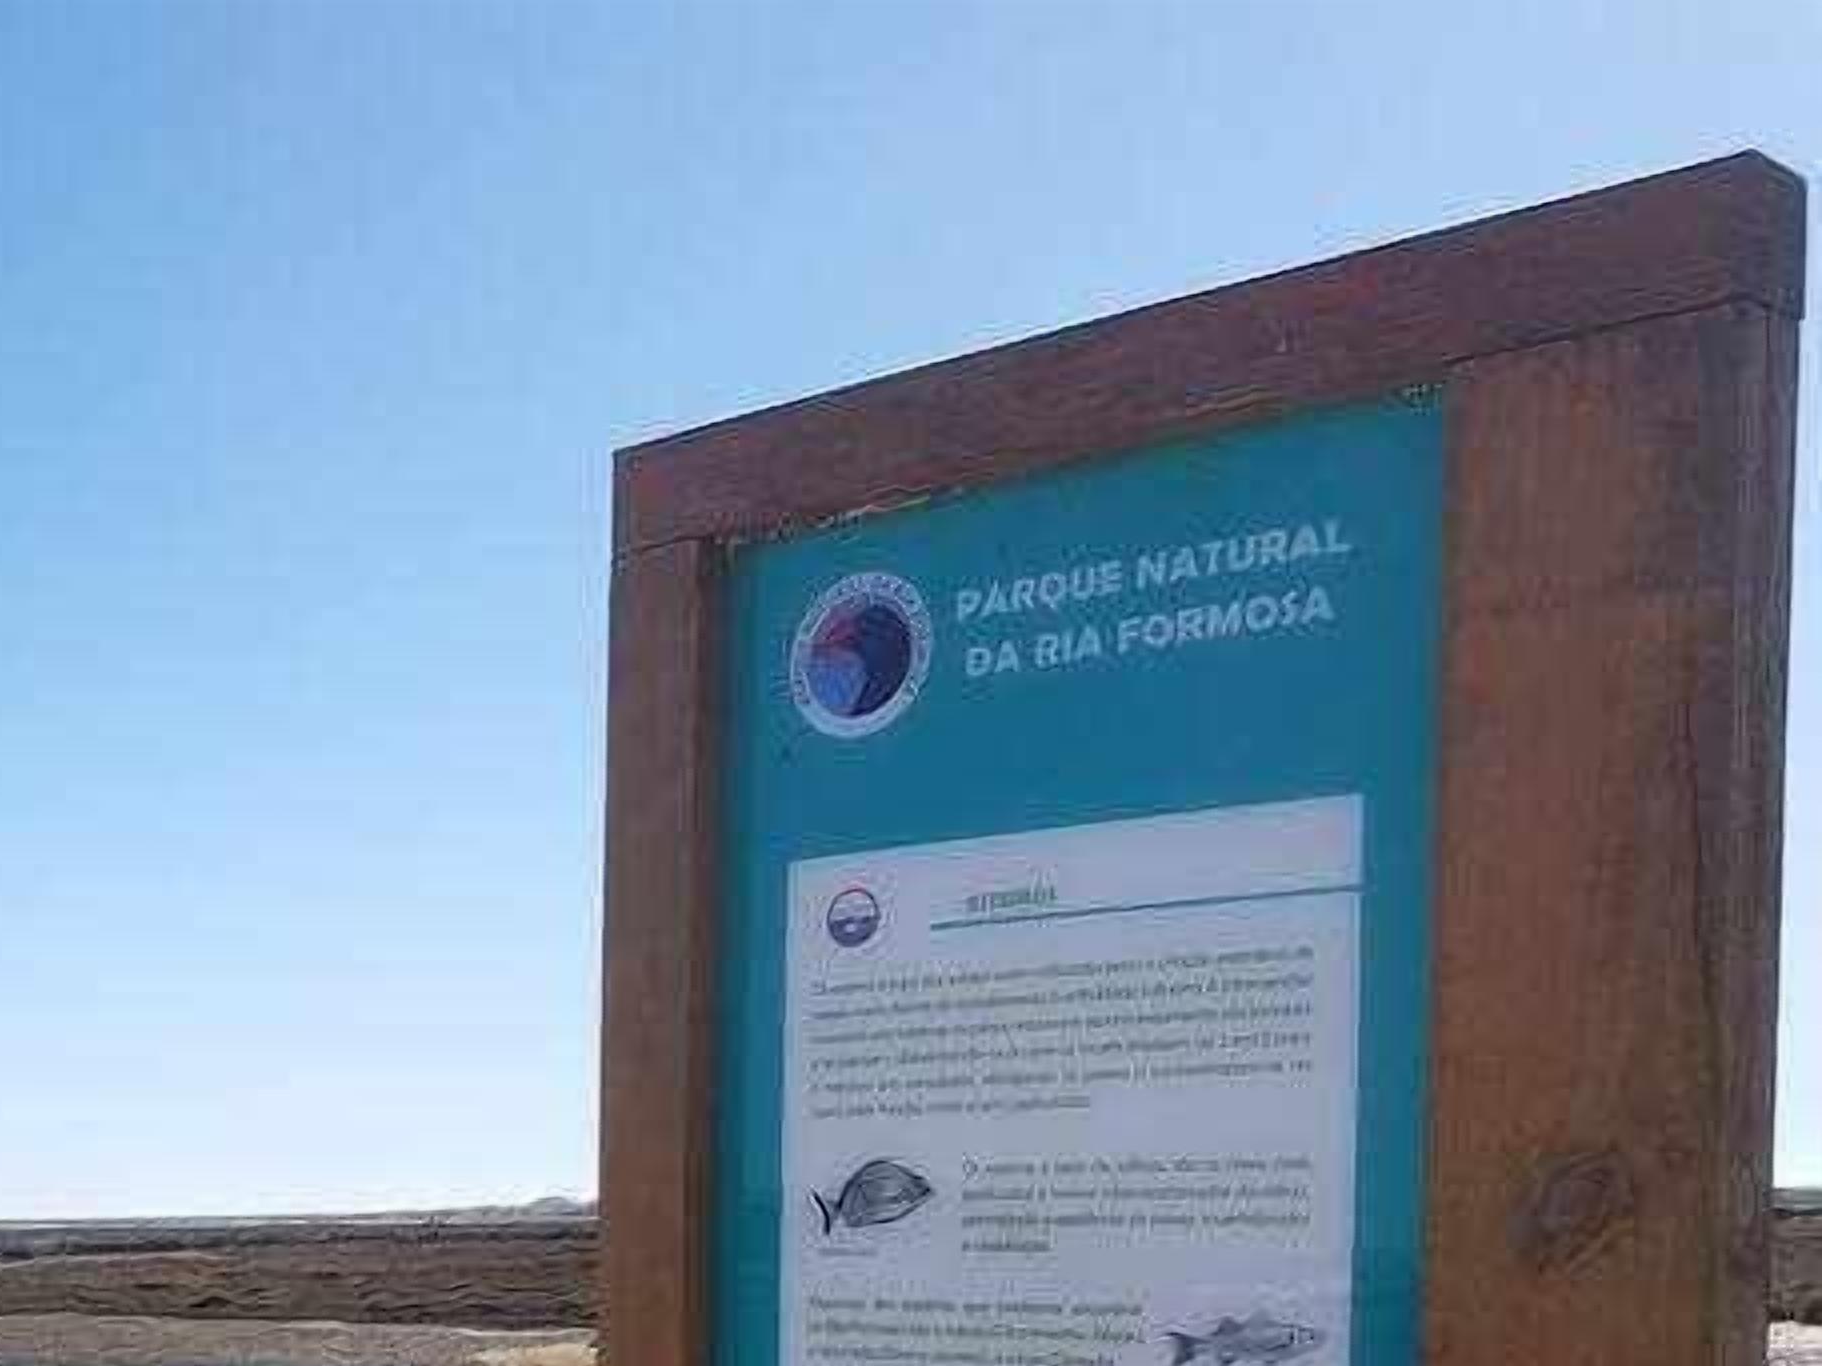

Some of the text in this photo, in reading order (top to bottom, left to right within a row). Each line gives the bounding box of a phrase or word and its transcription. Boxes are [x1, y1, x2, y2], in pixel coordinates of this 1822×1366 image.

[957, 518, 1352, 622] PARQUE NATURAL
[965, 585, 1336, 676] DA RIA FORMOSA
